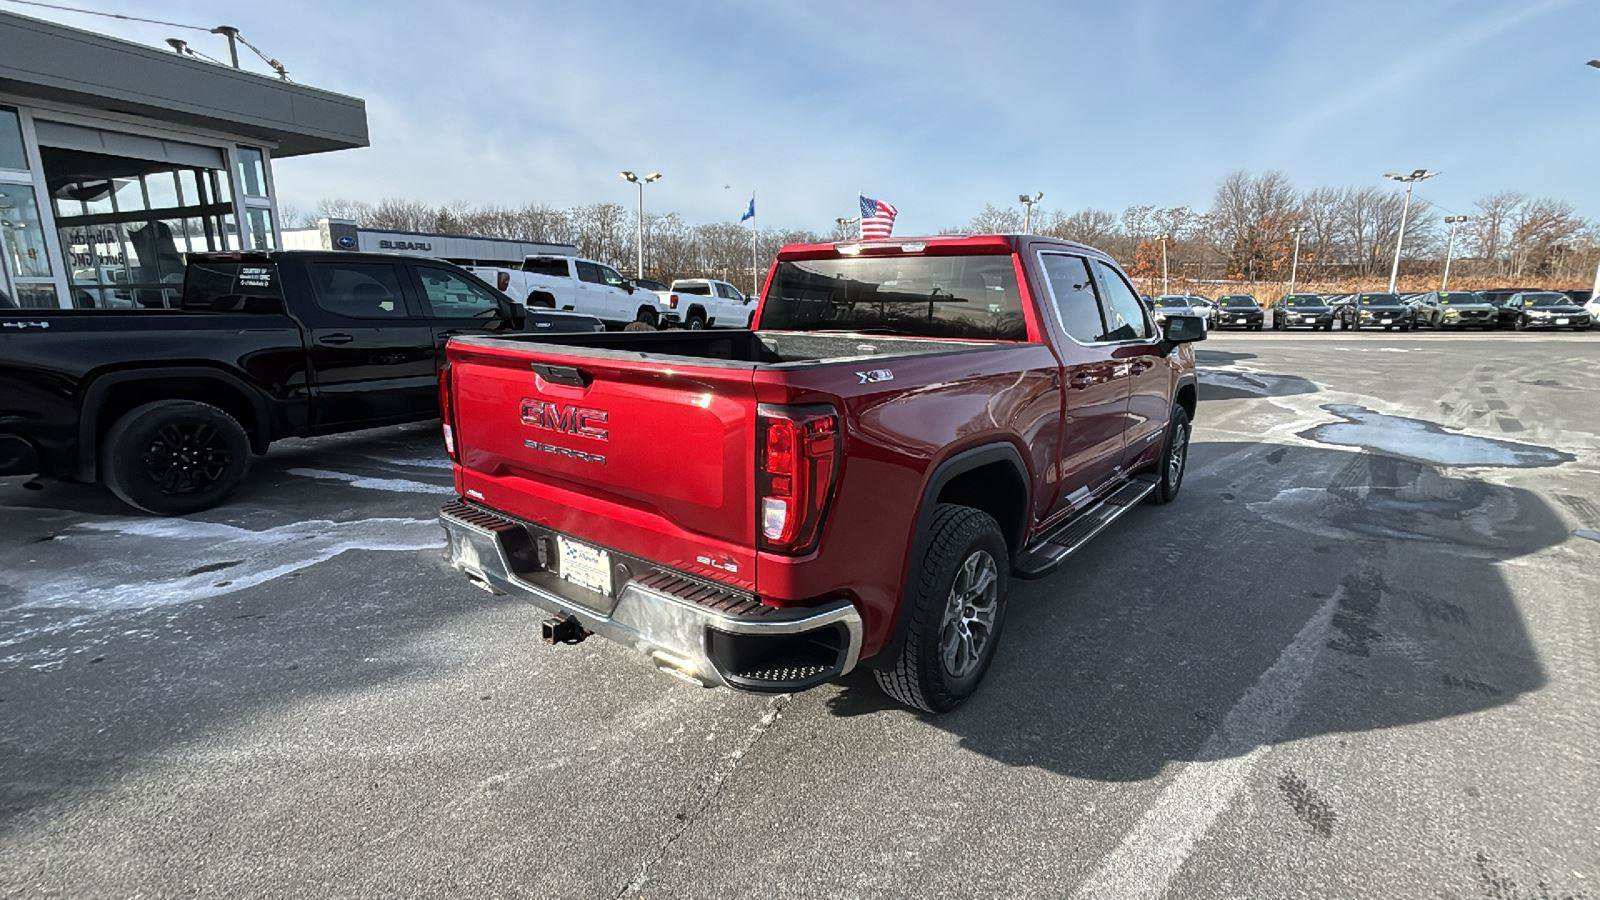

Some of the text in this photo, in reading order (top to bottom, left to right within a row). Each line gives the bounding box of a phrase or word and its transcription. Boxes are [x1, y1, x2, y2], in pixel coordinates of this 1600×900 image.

[380, 240, 432, 251] SUBARU
[519, 398, 609, 442] GMC
[523, 439, 606, 464] SIERRA
